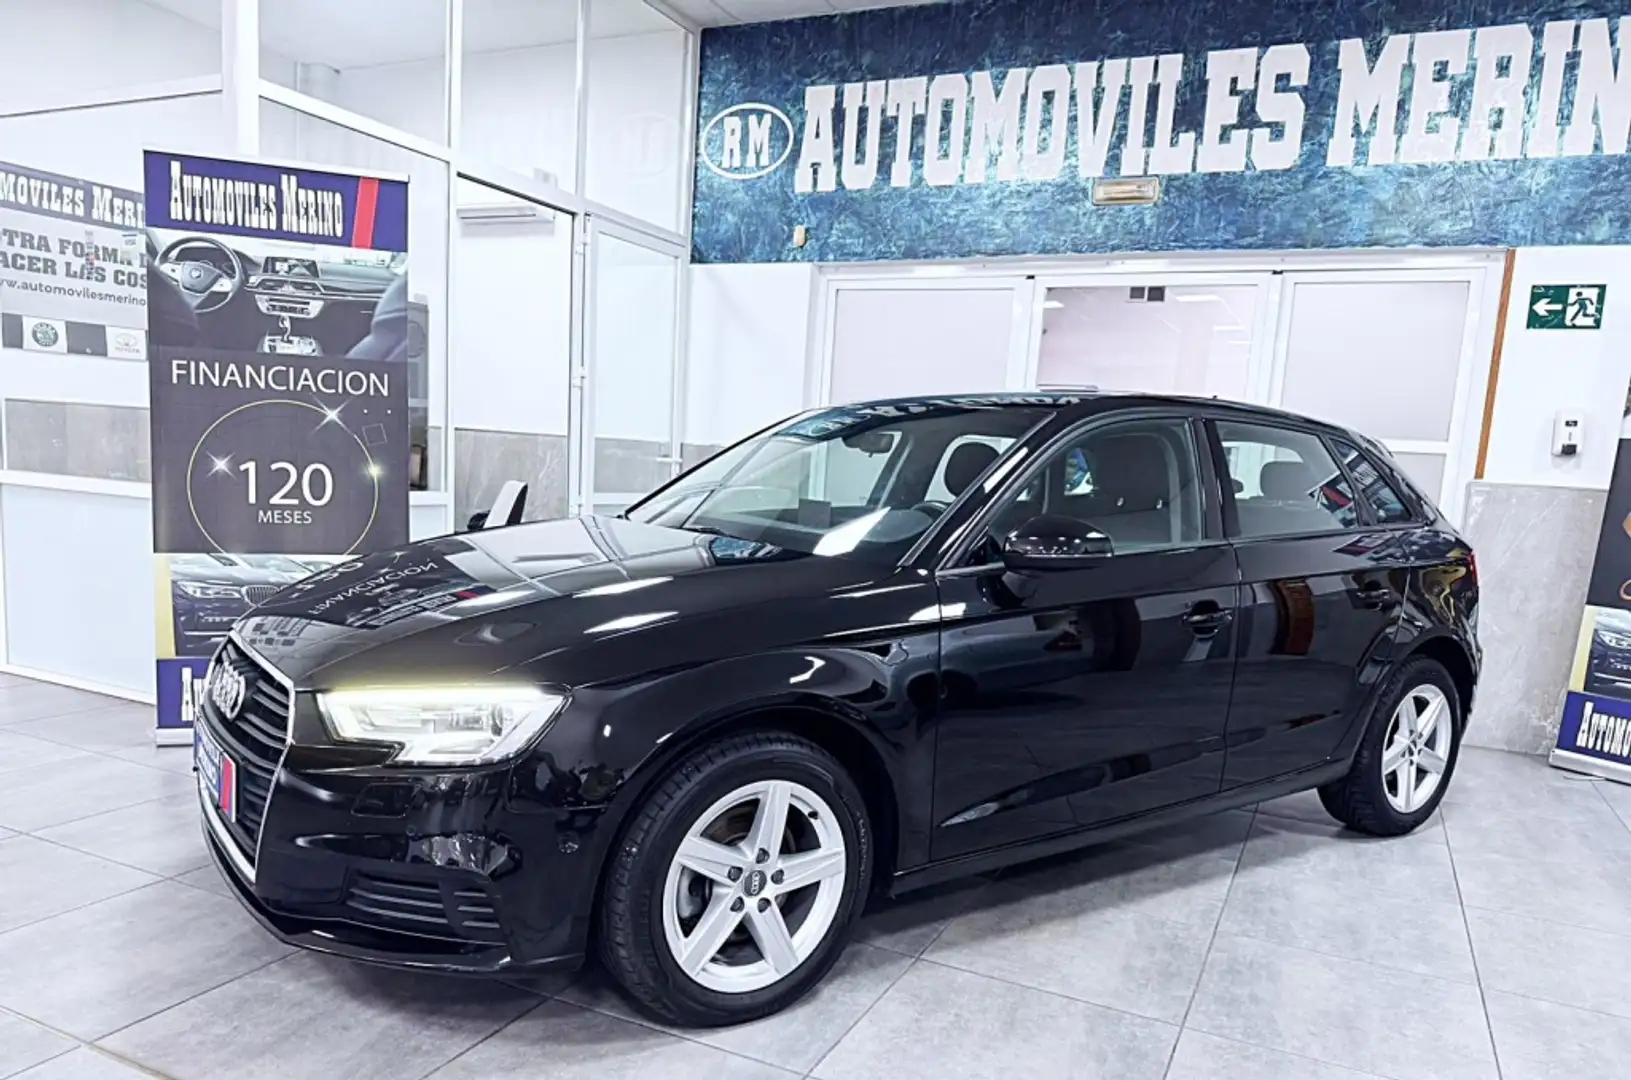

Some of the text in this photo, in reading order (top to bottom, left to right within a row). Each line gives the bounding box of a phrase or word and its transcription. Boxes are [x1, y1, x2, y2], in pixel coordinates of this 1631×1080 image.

[794, 15, 1631, 193] AUTOMOVILES MERIN
[721, 113, 772, 169] RM
[0, 228, 52, 253] TRA
[0, 279, 147, 306] w.automovilesmerino
[171, 360, 388, 396] FINANCIACION
[239, 461, 333, 506] 120
[258, 510, 312, 524] MESES
[1576, 701, 1631, 758] AUTOMO
